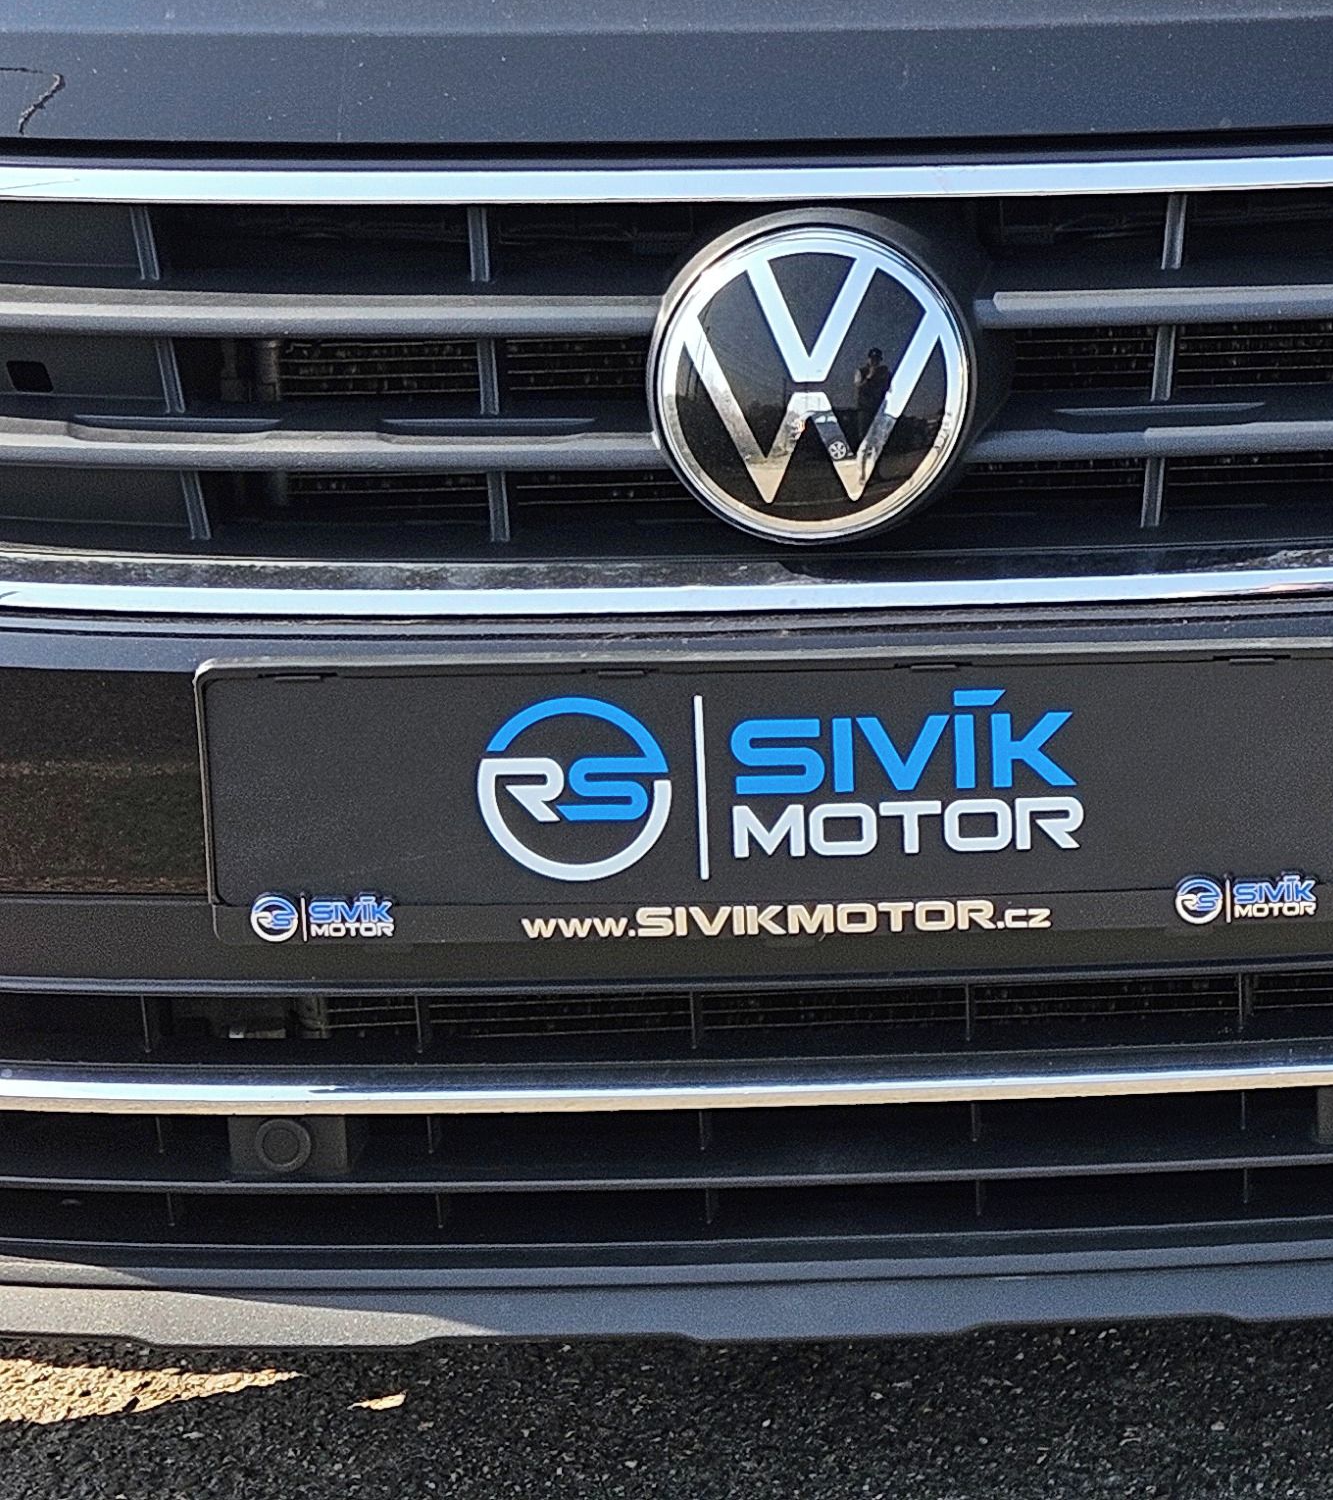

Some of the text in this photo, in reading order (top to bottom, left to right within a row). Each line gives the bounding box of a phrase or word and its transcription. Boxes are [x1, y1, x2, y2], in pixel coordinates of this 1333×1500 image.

[678, 245, 945, 504] VW
[733, 796, 1085, 859] MOTOR
[310, 922, 395, 938] MOTOR
[520, 899, 1052, 940] www.SIVIKMOTOR.cz
[1234, 902, 1316, 919] MOTOR
